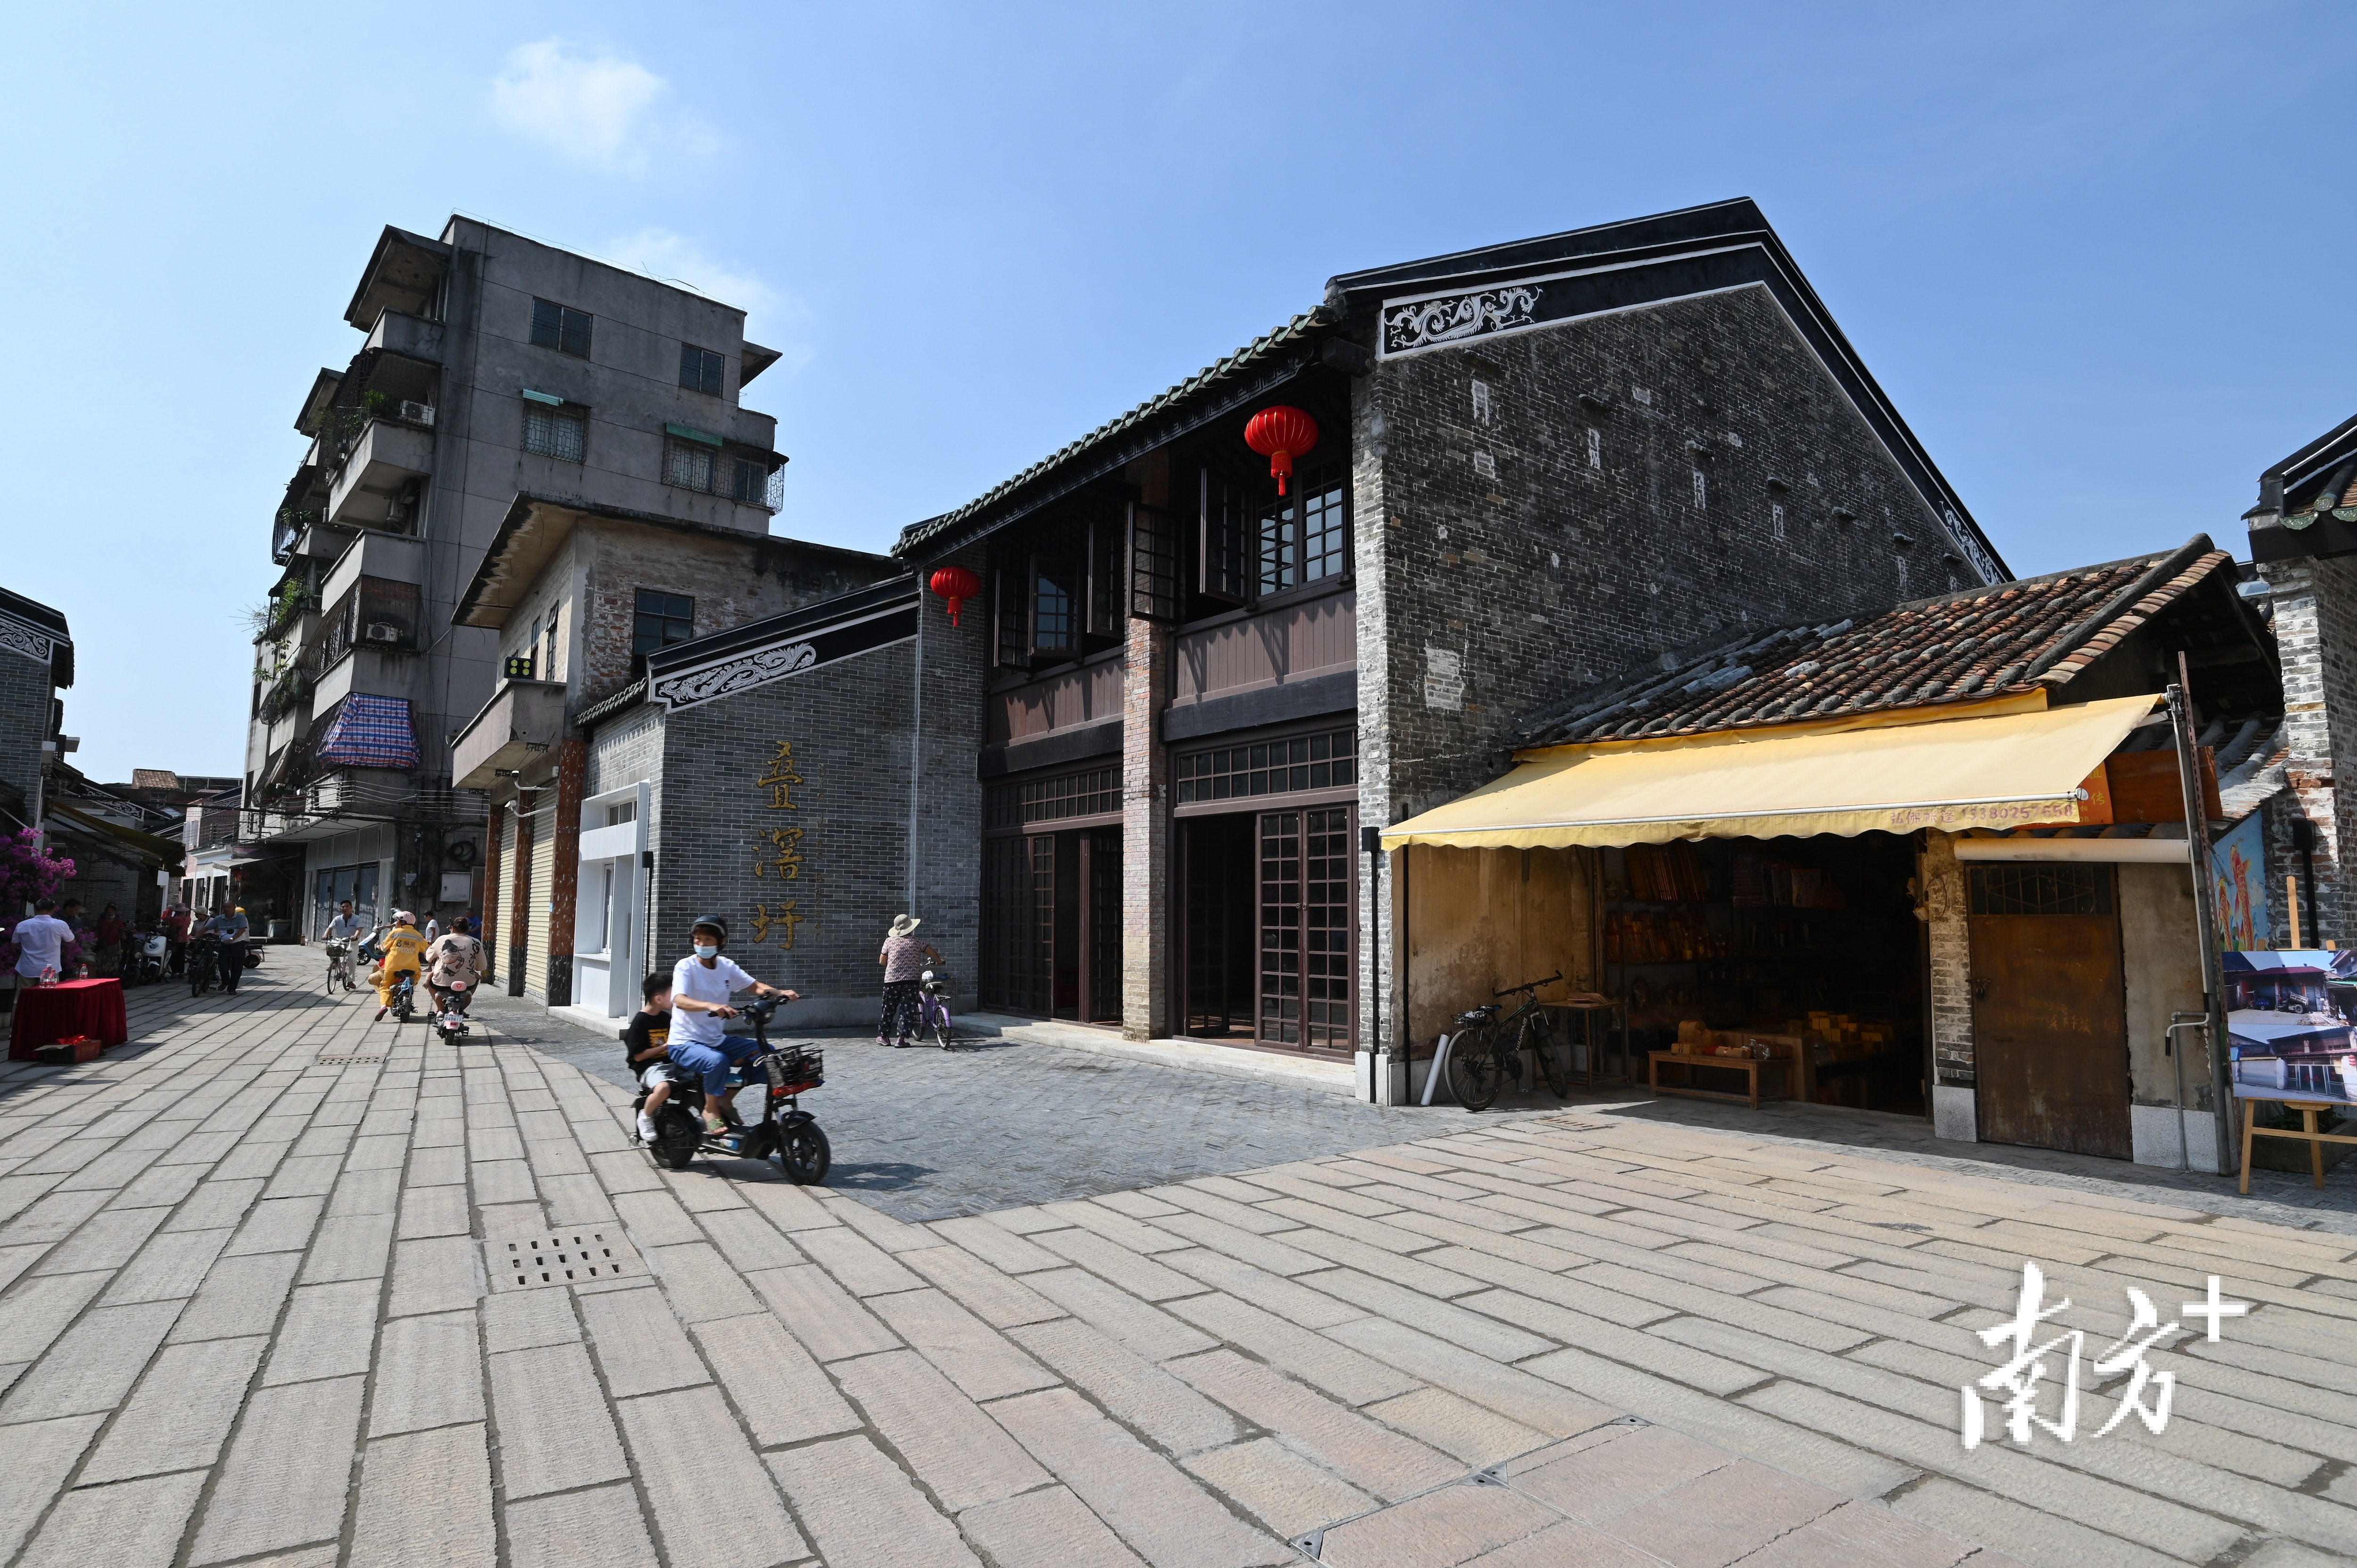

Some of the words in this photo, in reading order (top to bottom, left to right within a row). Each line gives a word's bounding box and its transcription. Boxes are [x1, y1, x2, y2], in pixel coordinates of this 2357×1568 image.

[817, 763, 825, 801] Die
[1961, 805, 2074, 821] 13380257658
[749, 740, 804, 950] 叠滘圩
[814, 872, 823, 941] Bazaar
